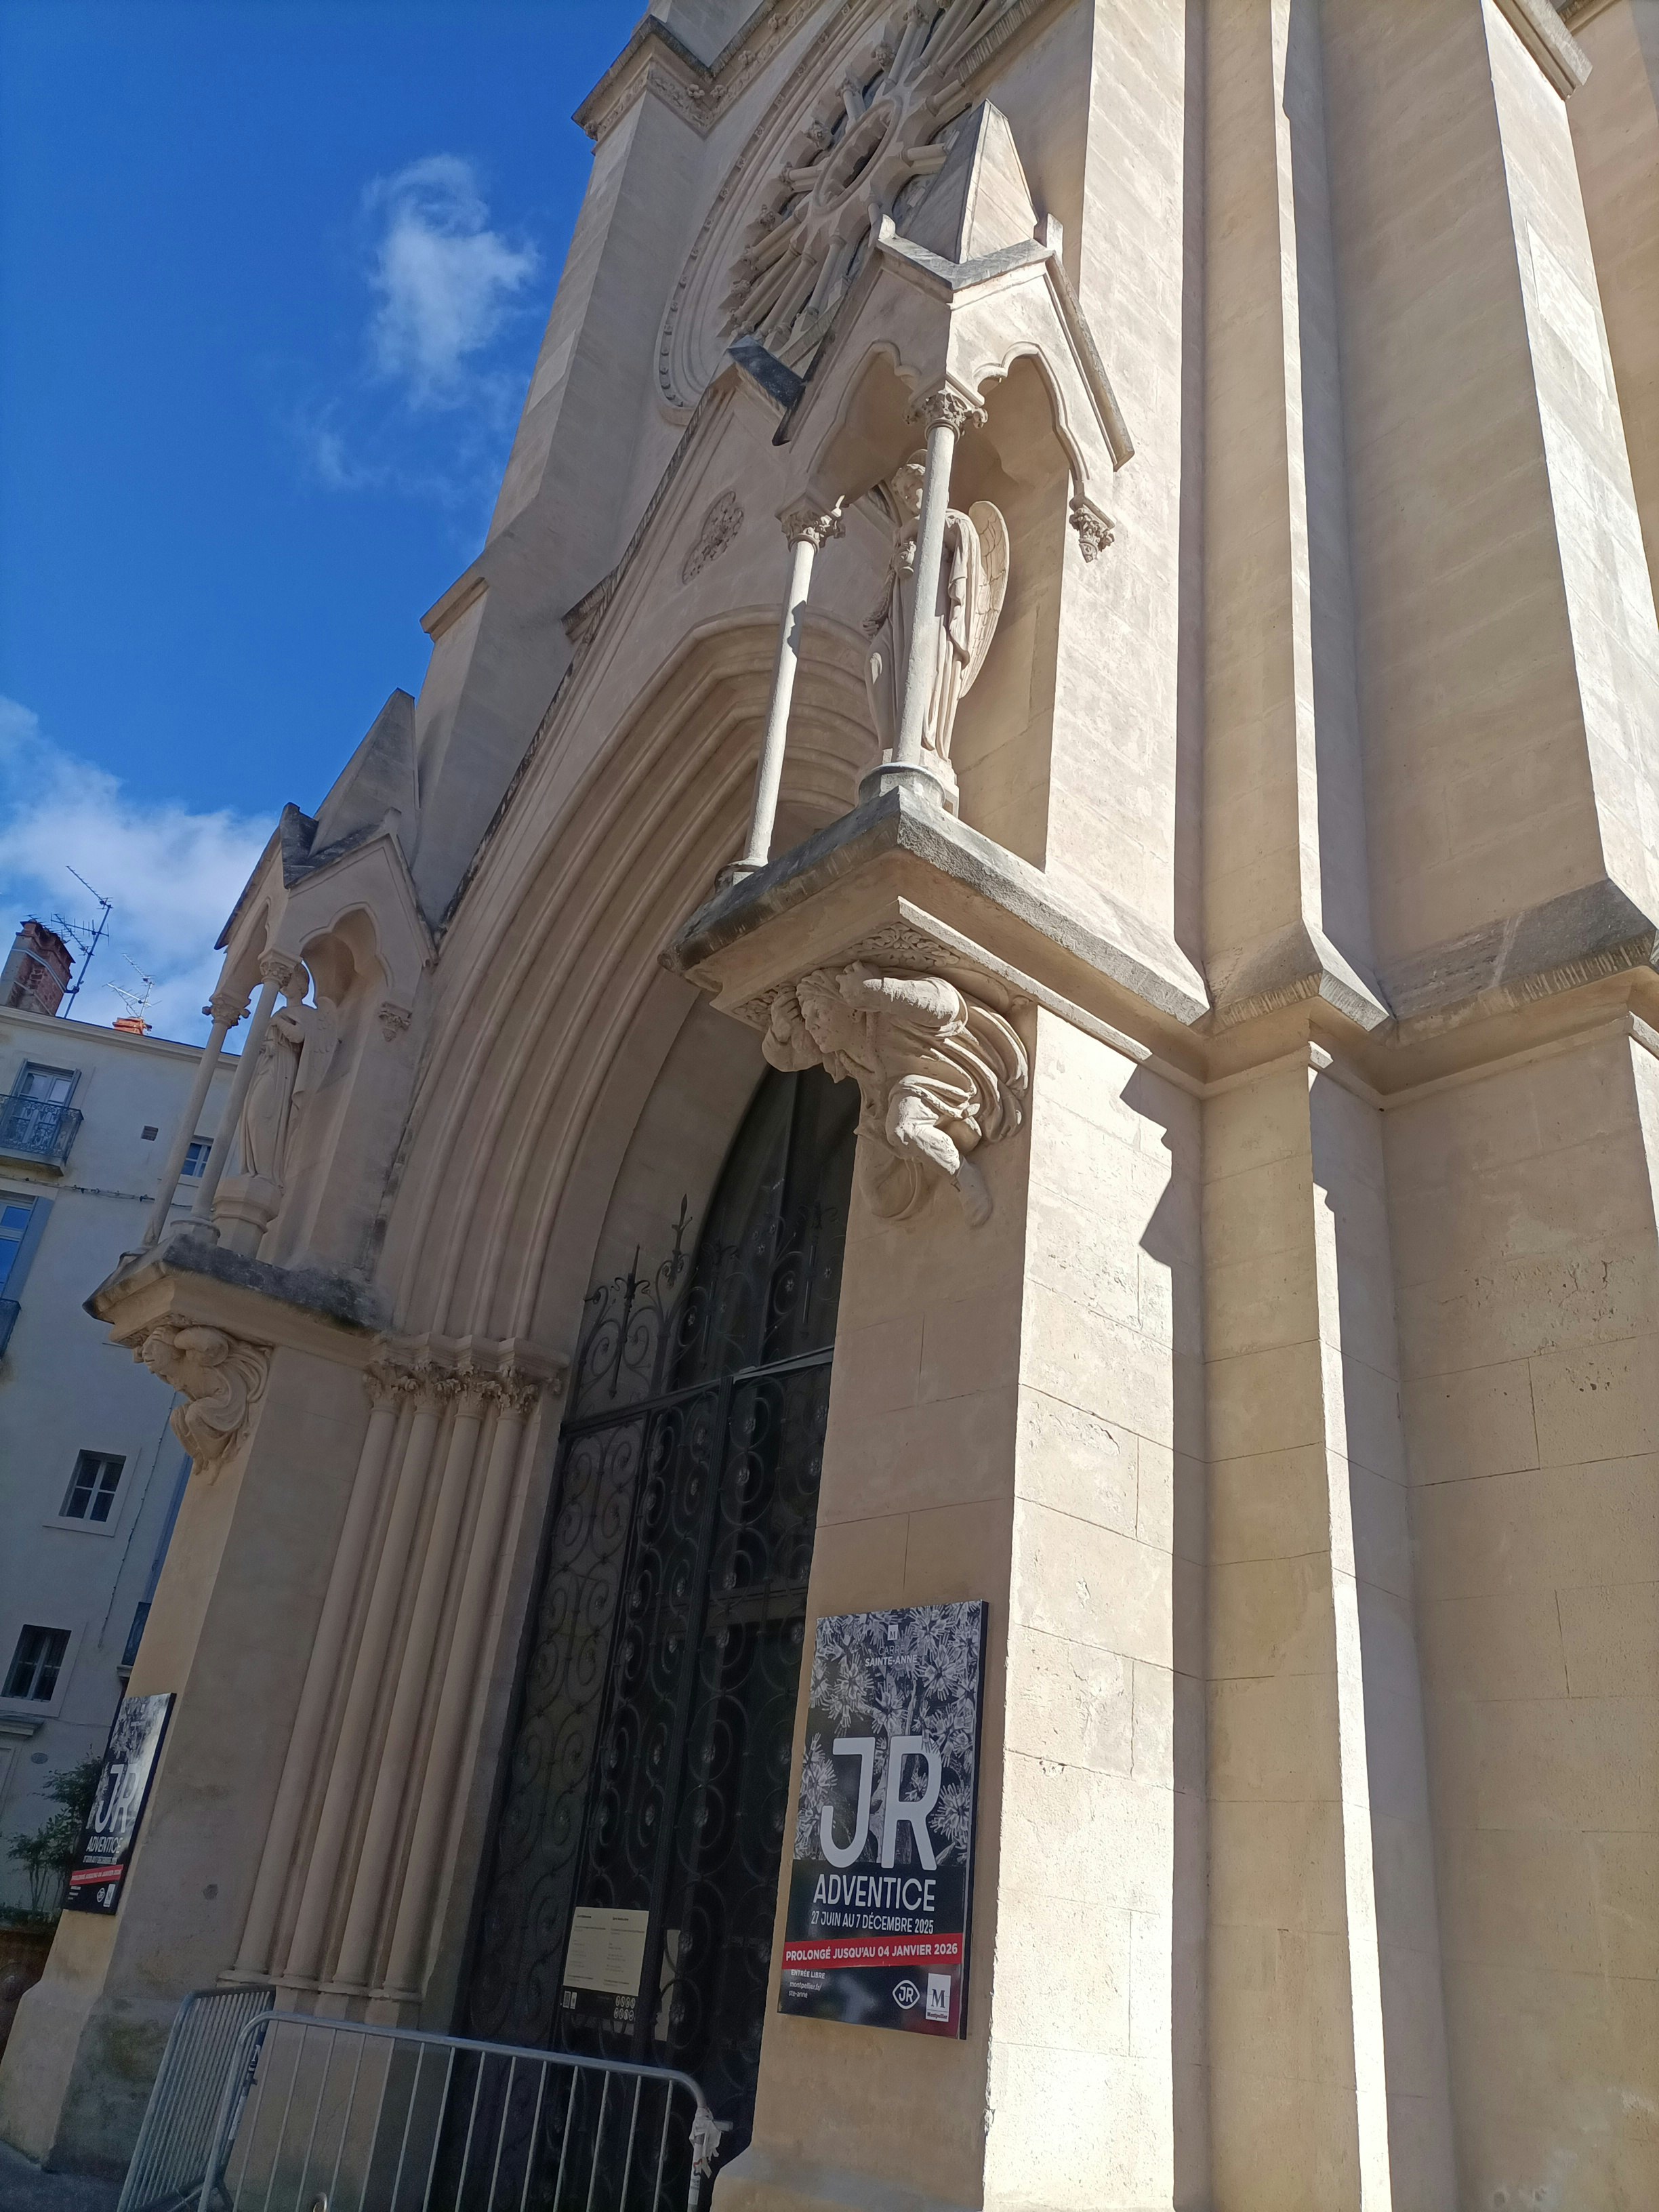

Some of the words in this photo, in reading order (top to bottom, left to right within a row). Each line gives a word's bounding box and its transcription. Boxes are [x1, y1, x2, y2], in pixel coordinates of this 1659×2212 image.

[865, 1654, 918, 1667] SAINTE-ANNE
[94, 1763, 140, 1833] JR
[819, 1735, 942, 1870] JR
[85, 1836, 123, 1853] ADVENTICE
[813, 1873, 937, 1912] ADVENTICE
[811, 1910, 819, 1925] 27
[821, 1911, 841, 1927] JUIN
[842, 1912, 855, 1927] AU
[855, 1914, 861, 1928] 7
[862, 1912, 913, 1933] DÉCEMBRE
[914, 1919, 934, 1934] 2025
[785, 1946, 831, 1961] PROLONGÉ
[832, 1946, 876, 1959] JUSQU'AU
[878, 1946, 890, 1957] 04
[891, 1944, 932, 1957] JANVIER
[934, 1943, 958, 1954] 2026
[791, 1969, 811, 1978] ENTRÉE
[898, 1986, 914, 2003] JR
[930, 1988, 945, 2008] M
